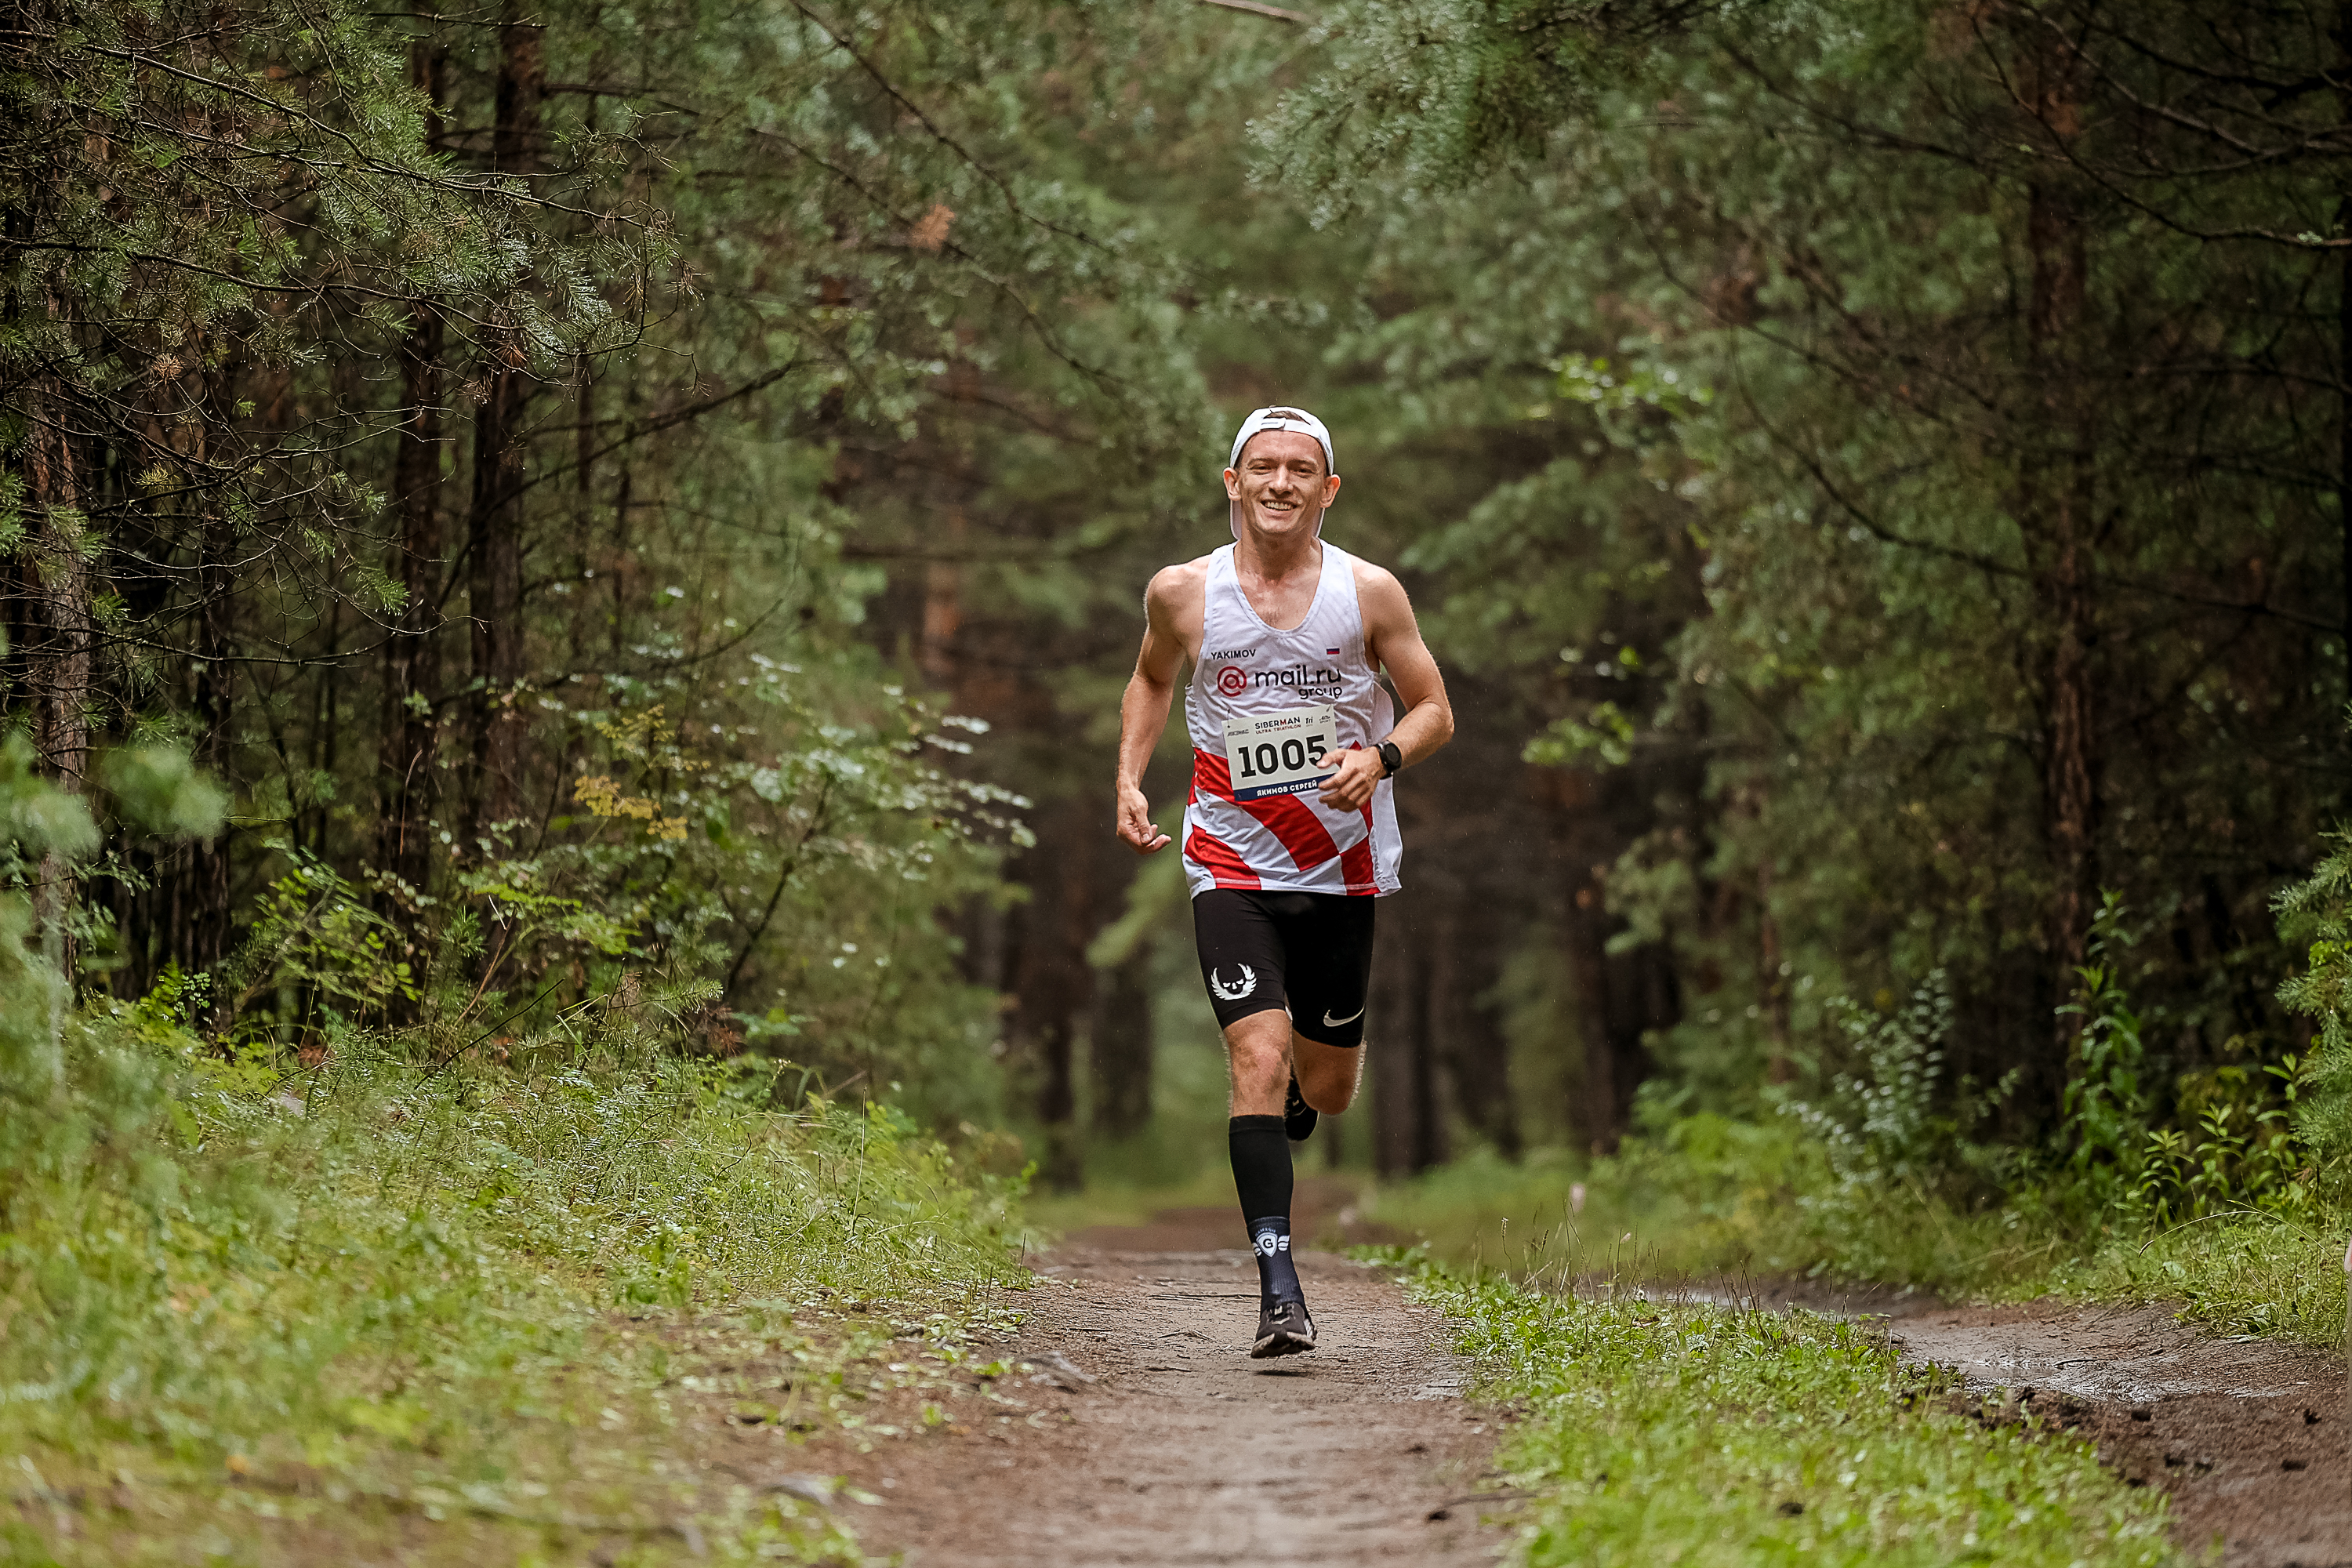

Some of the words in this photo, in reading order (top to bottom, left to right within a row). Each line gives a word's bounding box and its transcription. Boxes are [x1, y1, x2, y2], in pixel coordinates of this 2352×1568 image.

[1210, 649, 1256, 660] YAKIMOV
[1255, 664, 1342, 688] mail.ru
[1298, 686, 1343, 699] group
[1254, 717, 1301, 730] SIBERMAN
[1238, 734, 1327, 779] 1005
[1257, 786, 1289, 797] ЯКИМОВ
[1289, 779, 1318, 792] СЕРГЕЙ
[1263, 1239, 1273, 1248] G
